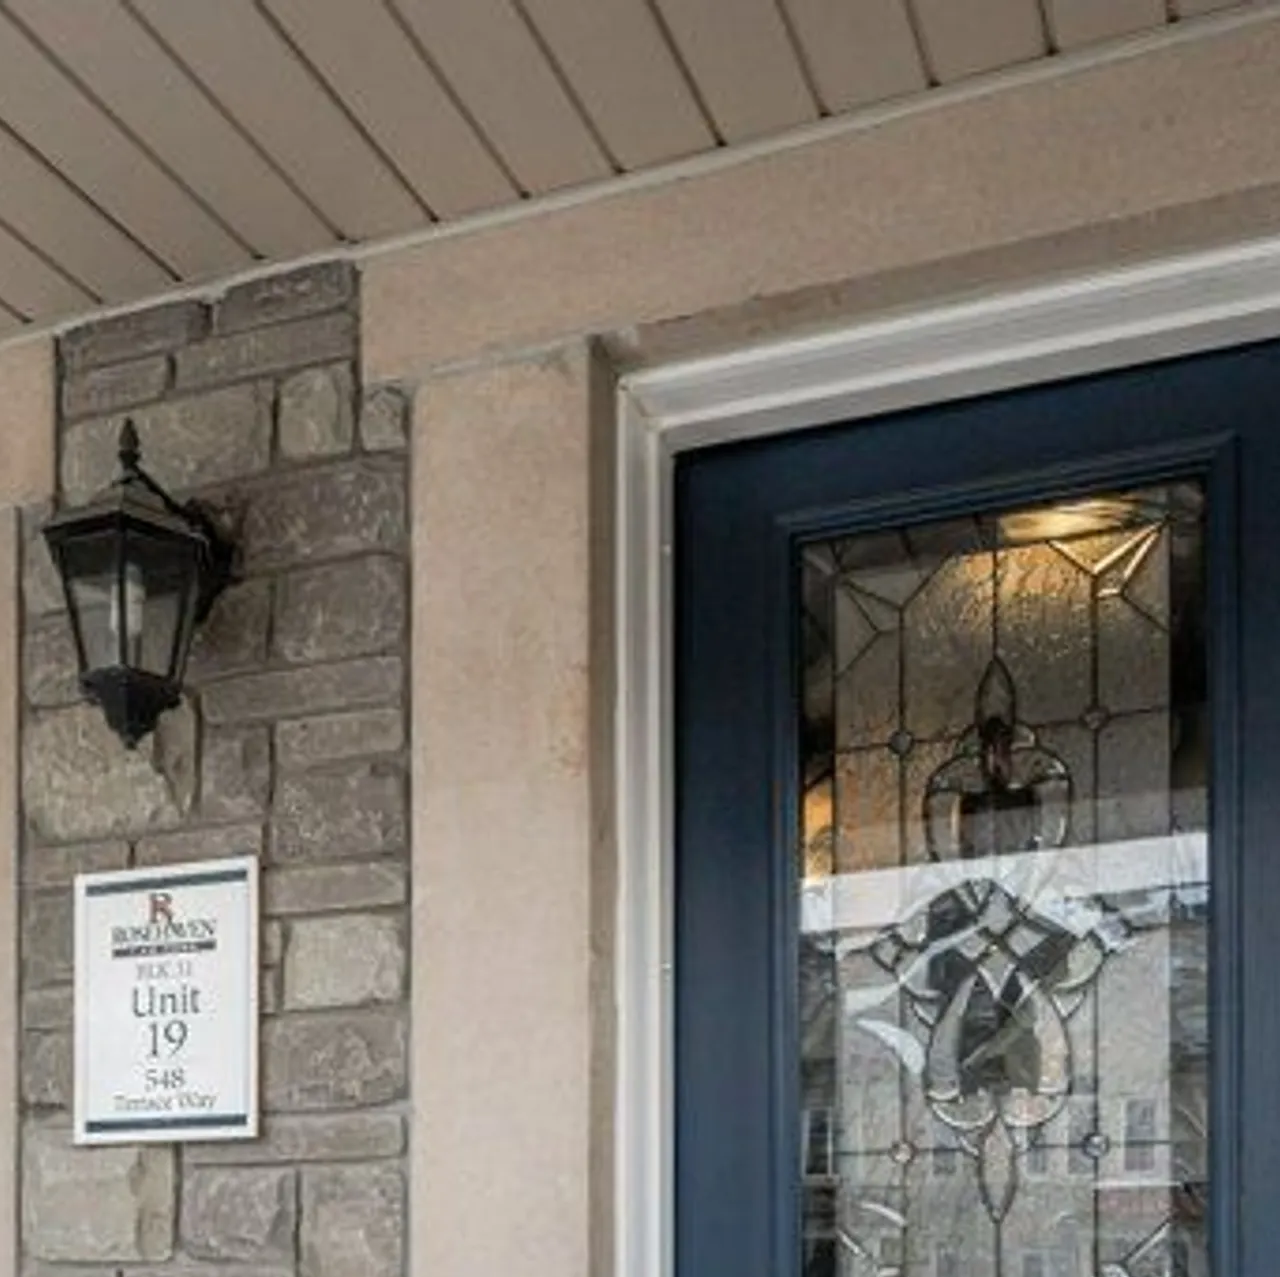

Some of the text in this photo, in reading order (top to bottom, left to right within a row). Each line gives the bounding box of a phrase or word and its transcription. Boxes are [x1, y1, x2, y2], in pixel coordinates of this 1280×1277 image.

[147, 892, 173, 928] R
[132, 984, 201, 1017] Unit
[147, 1019, 188, 1058] 19
[144, 1068, 185, 1092] 548
